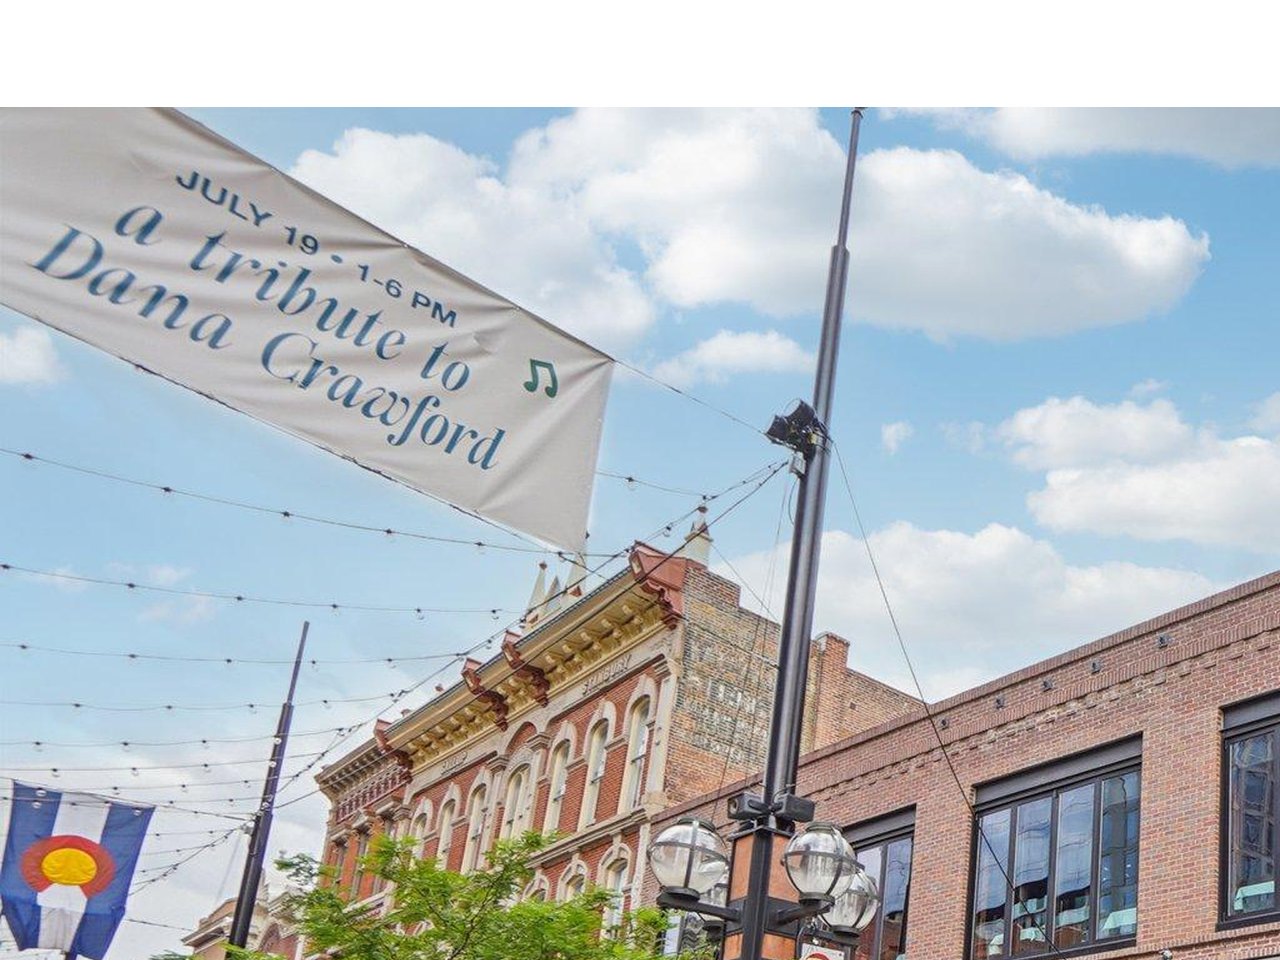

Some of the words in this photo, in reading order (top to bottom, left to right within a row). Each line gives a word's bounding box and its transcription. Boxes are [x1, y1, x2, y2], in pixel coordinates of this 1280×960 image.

[113, 205, 163, 246] a
[189, 231, 406, 360] tribute
[419, 340, 470, 392] to
[175, 170, 273, 227] JULY
[284, 225, 319, 255] 19
[357, 263, 403, 298] 1-6
[411, 290, 457, 328] PM
[24, 223, 233, 350] Dana
[260, 332, 506, 471] Crawford
